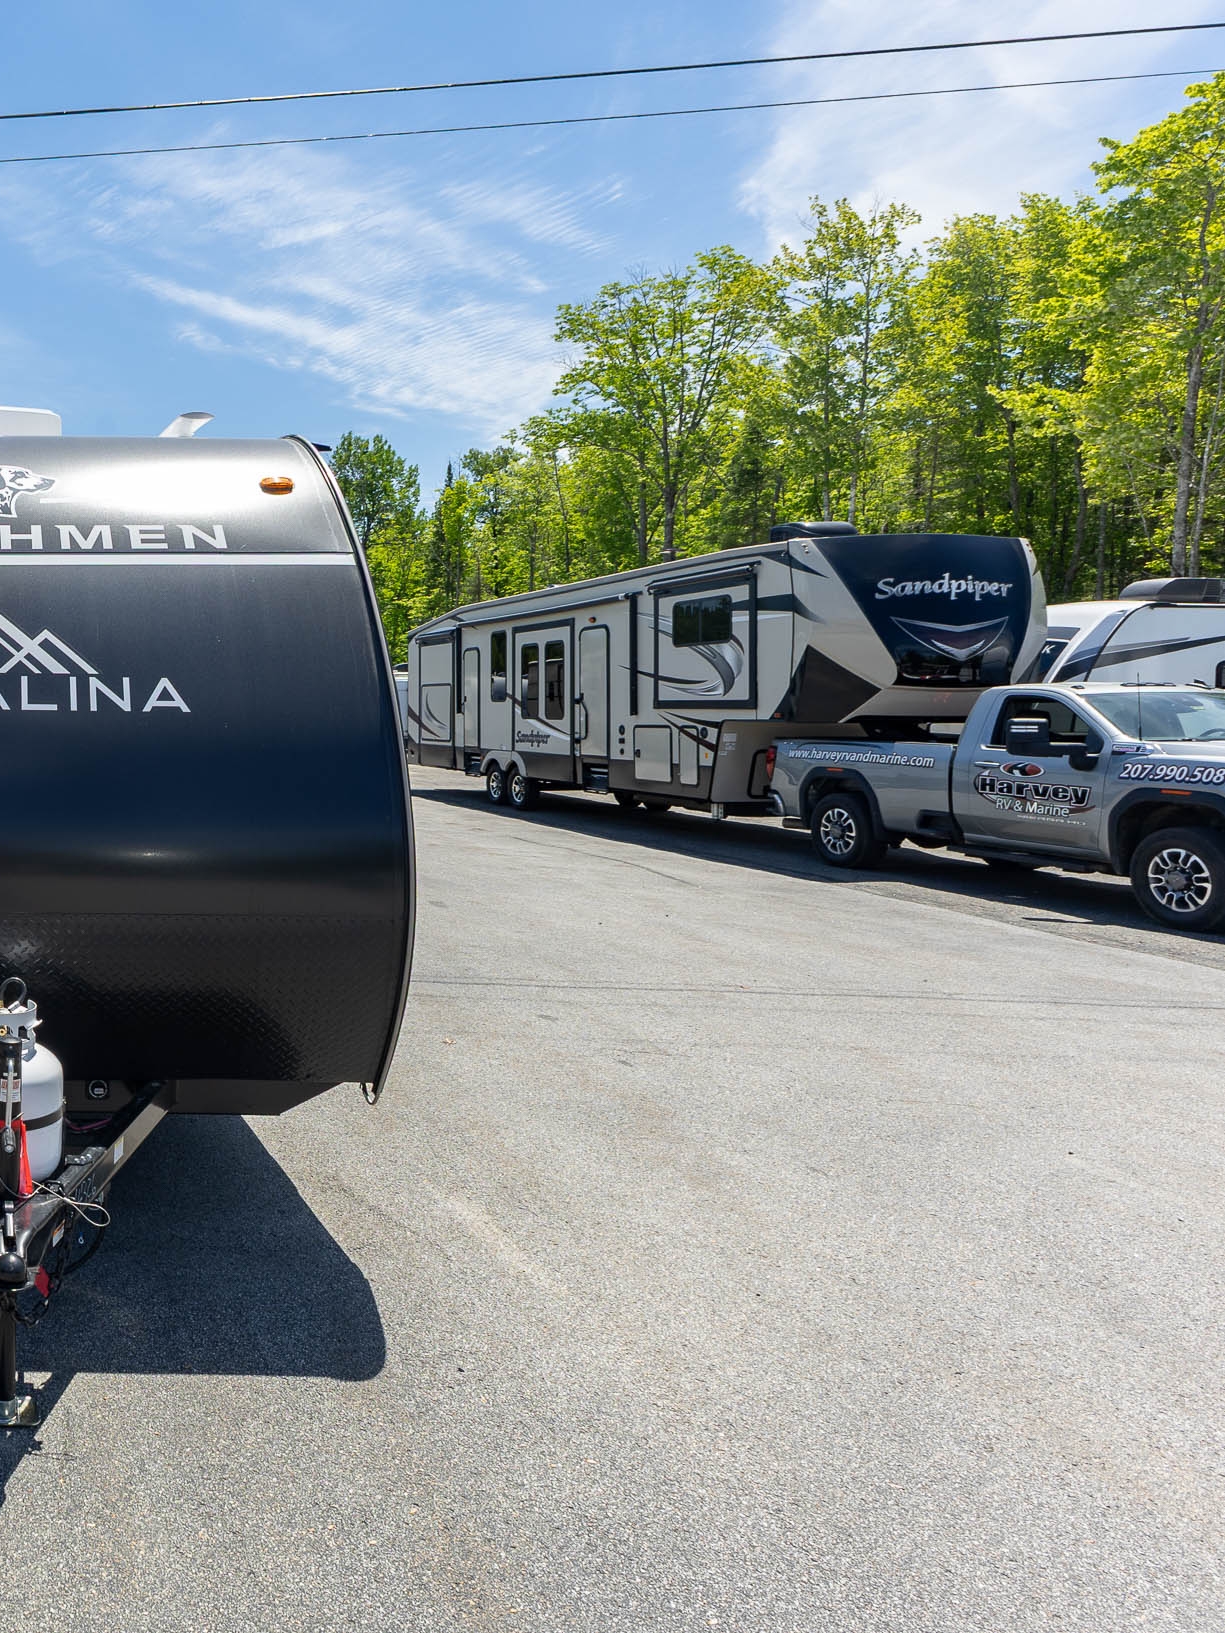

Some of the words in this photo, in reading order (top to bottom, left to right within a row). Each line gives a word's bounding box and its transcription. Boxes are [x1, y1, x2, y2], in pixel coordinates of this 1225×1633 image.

[875, 573, 1013, 601] Sandpiper
[788, 747, 935, 768] www.harveyrvandmarine.com
[978, 775, 1091, 807] Harvey
[995, 798, 1012, 810] RV
[1013, 799, 1023, 812] &
[1025, 801, 1070, 817] Marine
